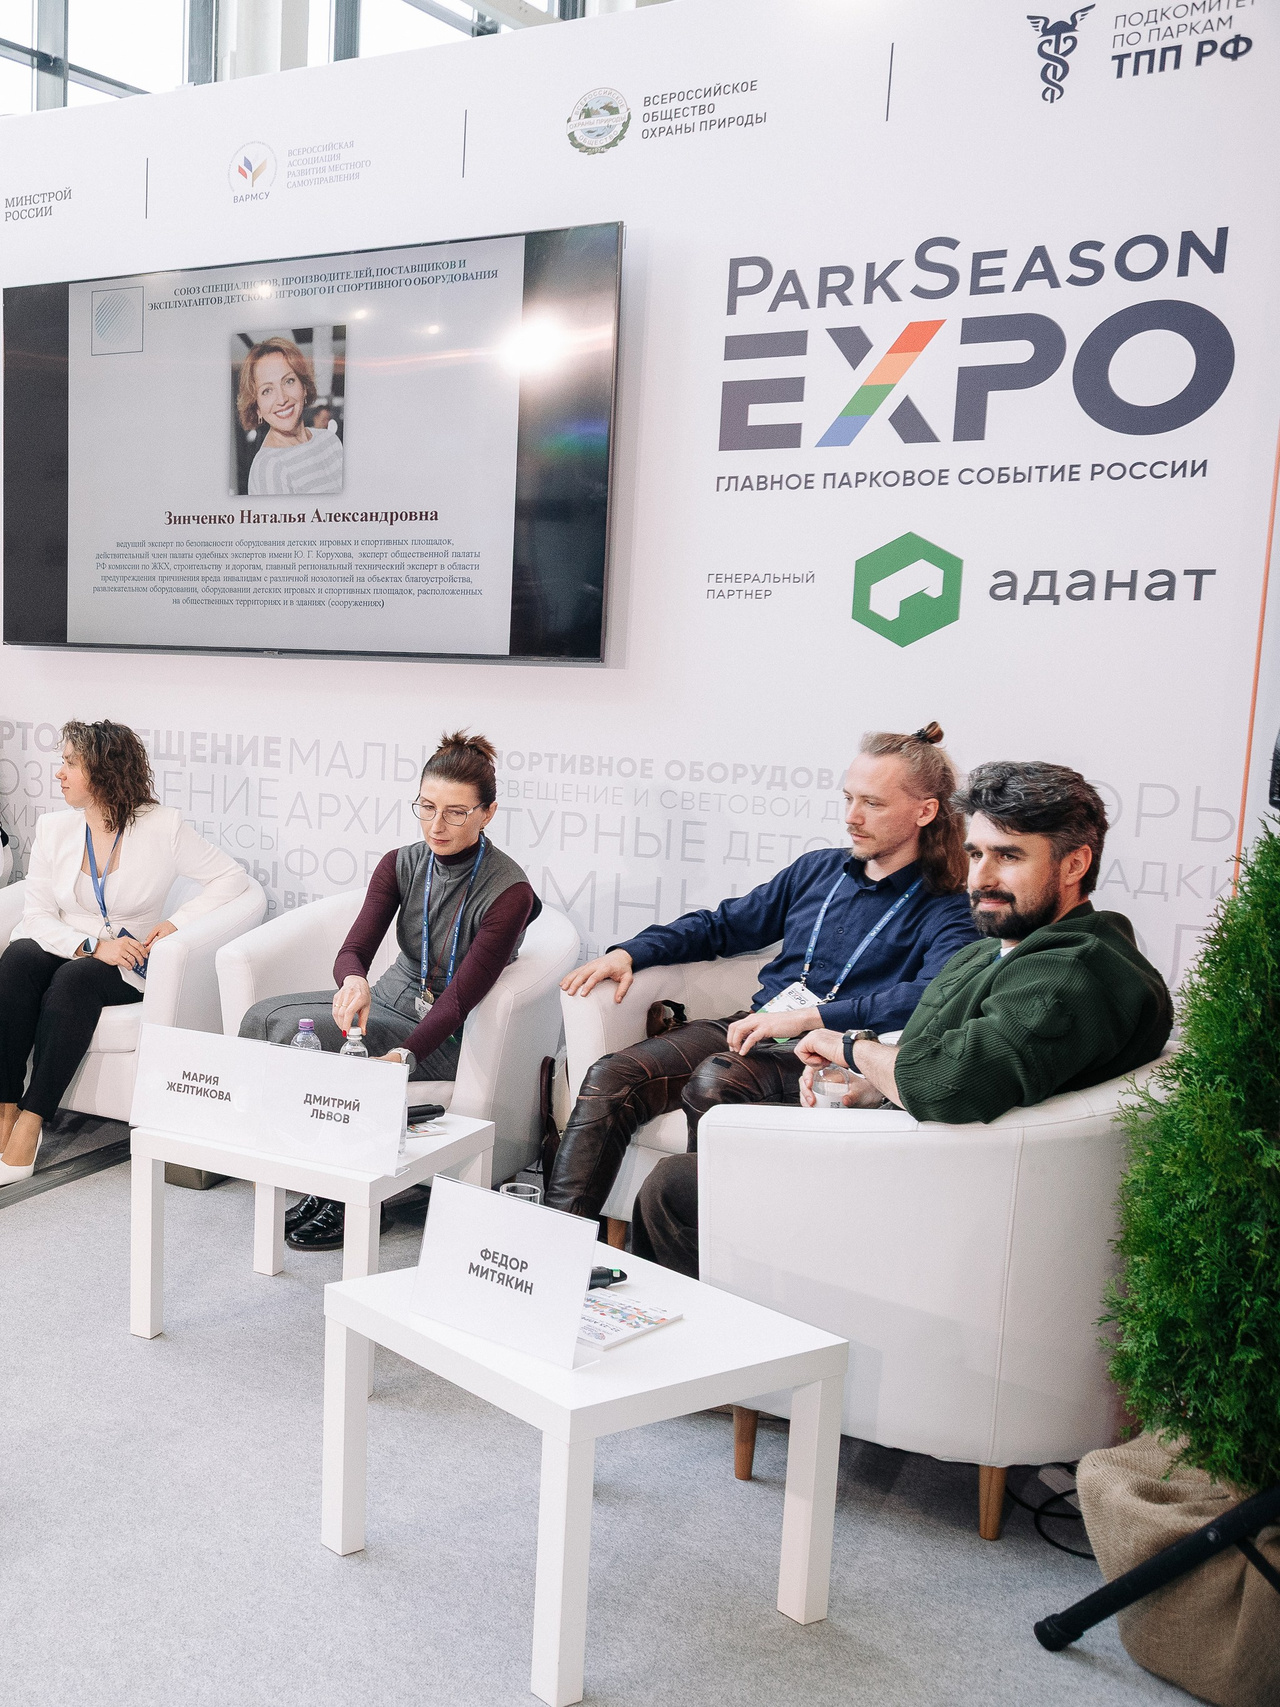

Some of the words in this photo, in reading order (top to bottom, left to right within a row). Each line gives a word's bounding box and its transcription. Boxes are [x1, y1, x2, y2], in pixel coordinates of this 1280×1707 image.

[1112, 31, 1142, 49] ПО
[1148, 15, 1233, 43] ПАРКАМ
[1111, 44, 1183, 79] ТПП
[1195, 33, 1253, 67] РФ
[643, 79, 758, 107] ВСЕРОССИЙСКОЕ
[642, 102, 716, 123] ОБЩЕСТВО
[641, 122, 695, 140] ОХРАНЫ
[699, 111, 767, 132] ПРИРОДЫ
[287, 140, 355, 157] ВСЕРОССИЙСКАЯ
[286, 165, 327, 179] РАЗВИТИЯ
[327, 159, 372, 173] МЕСТНОГО
[287, 152, 342, 168] АССОЦИАЦИЯ
[286, 172, 361, 190] САМОУПРАВЛЕНИЯ
[4, 186, 73, 208] МИНСТРОЙ
[233, 191, 271, 204] ВАРМСУ
[4, 205, 53, 222] РОССИИ
[173, 286, 201, 297] СОЮЗ
[281, 267, 375, 287] ПРОИЗВОДИТЕЛЕЙ,
[375, 259, 457, 277] ПОСТАВЩИКОВ
[457, 259, 467, 269] И
[147, 296, 223, 311] ЭКСПЛУАТАНТОВ
[275, 285, 327, 299] ИГРОВОГО
[327, 285, 335, 294] И
[336, 276, 412, 294] СПОРТИВНОГО
[413, 269, 499, 286] ОБОРУДОВАНИЯ
[718, 298, 1236, 452] EXPO
[715, 472, 816, 493] ГЛАВНОЕ
[822, 467, 951, 490] ПАРКОВОЕ
[957, 462, 1082, 488] СОБЫТИЕ
[1090, 458, 1209, 483] РОССИИ
[164, 510, 235, 526] Зинченко
[239, 509, 306, 525] Наталья
[310, 508, 439, 526] Александровна
[286, 539, 317, 548] детских
[707, 570, 816, 584] ГЕНЕРАЛЬНЫЙ
[988, 566, 1217, 606] аданат
[706, 588, 773, 600] ПАРТНЕР
[634, 788, 649, 808] И
[659, 790, 810, 819] СВЕТОВОЙ
[181, 1070, 220, 1086] МАРИЯ
[166, 1080, 232, 1103] ЖЕЛТИКОВА
[303, 1092, 361, 1112] ДМИТРИЙ
[310, 1107, 351, 1125] ЛЬВОВ
[480, 1248, 529, 1274] ФЕДОР
[467, 1261, 534, 1296] МИТЯКИН
